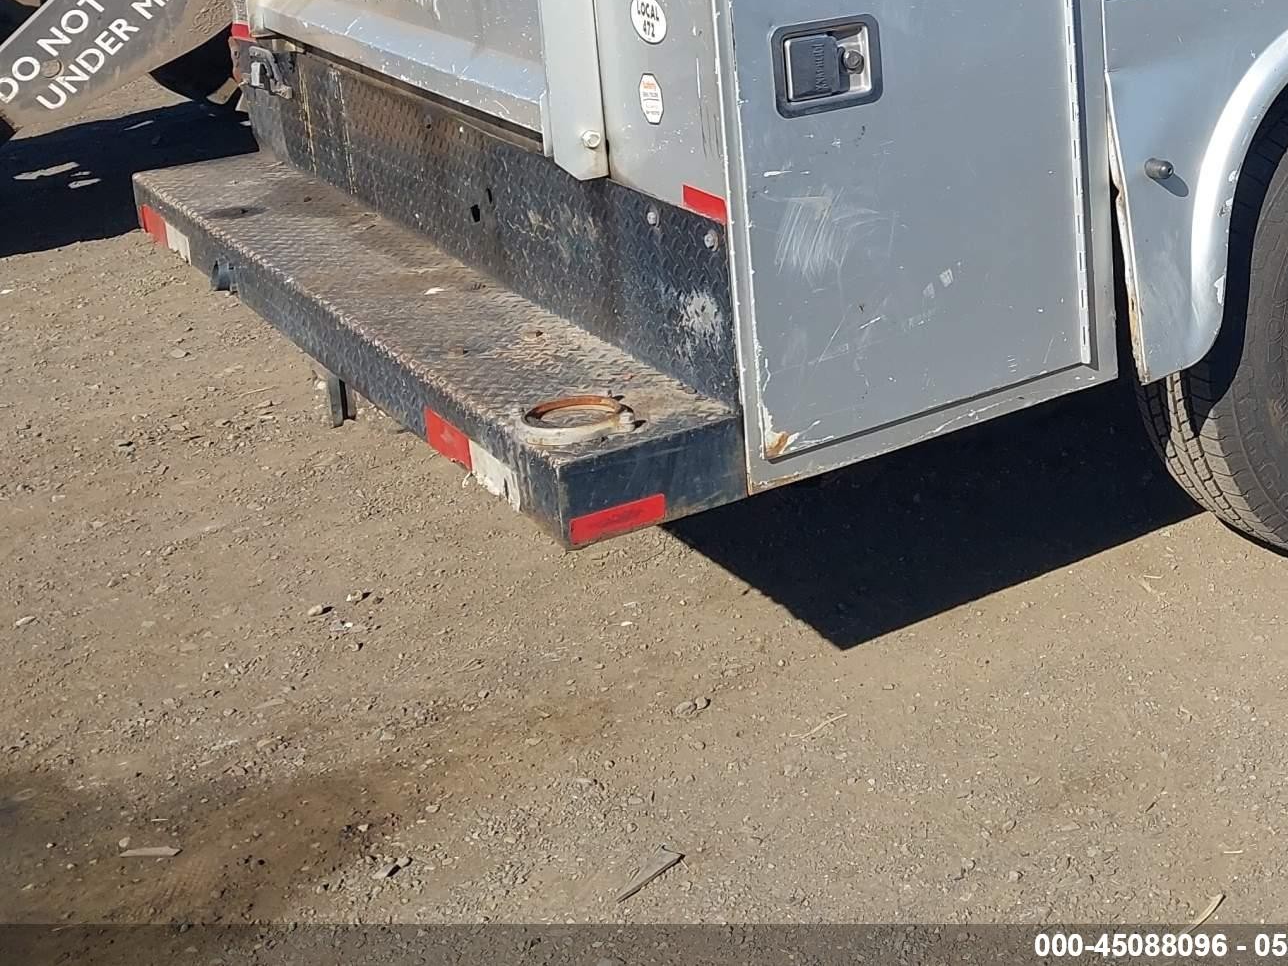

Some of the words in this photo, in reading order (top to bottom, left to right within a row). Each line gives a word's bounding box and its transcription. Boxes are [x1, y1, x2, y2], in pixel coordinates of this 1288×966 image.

[636, 0, 660, 22] LOCAL
[643, 21, 656, 38] 472
[0, 56, 41, 104] DO
[36, 18, 140, 110] UNDER
